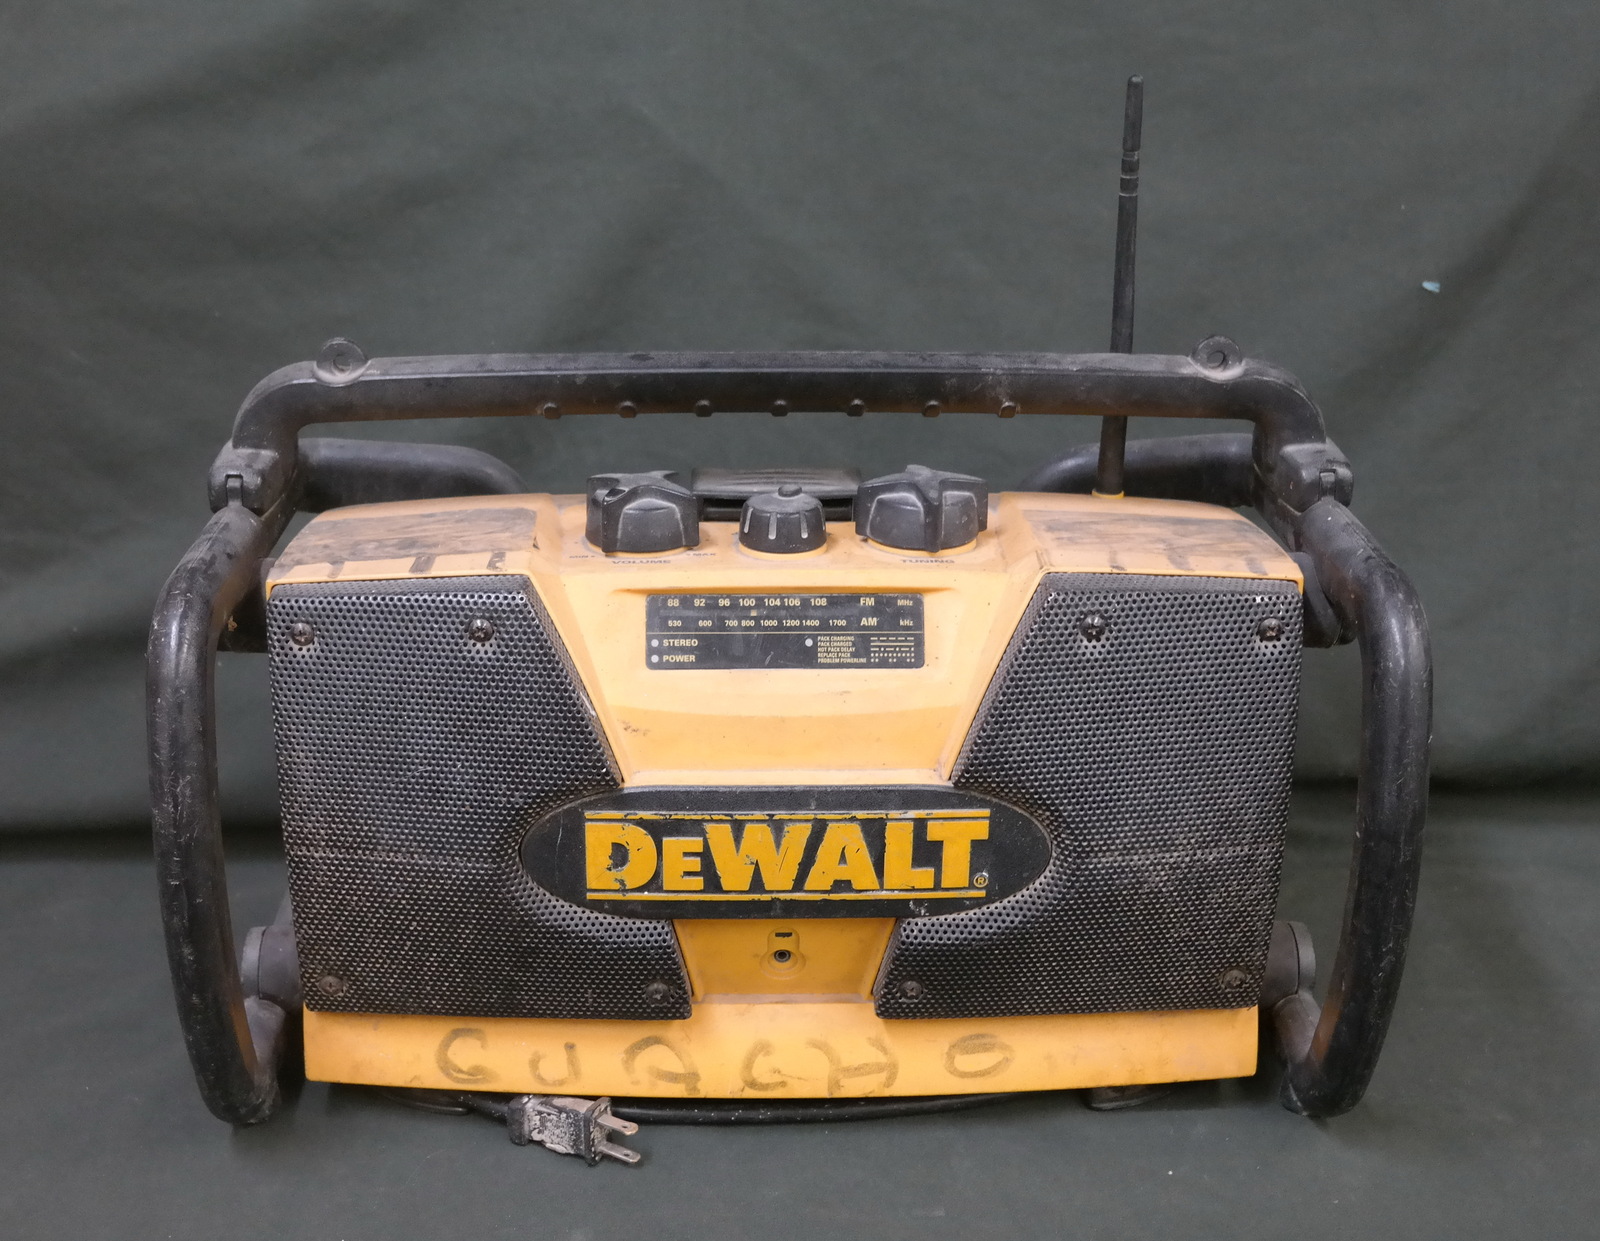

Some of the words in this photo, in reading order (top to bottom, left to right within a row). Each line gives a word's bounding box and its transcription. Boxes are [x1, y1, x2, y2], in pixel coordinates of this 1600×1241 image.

[667, 598, 680, 607] 88
[693, 598, 706, 607] 92
[718, 598, 731, 607] 96
[738, 598, 756, 607] 100
[764, 598, 781, 607] 104
[783, 597, 801, 607] 106
[810, 597, 828, 606] 108
[860, 597, 875, 606] FM
[782, 619, 800, 627] 1200
[802, 619, 820, 627] 1400
[829, 619, 847, 627] 1700
[860, 617, 878, 627] AM
[899, 619, 914, 627] kHz
[662, 639, 699, 647] STEREO
[662, 654, 696, 663] POWER
